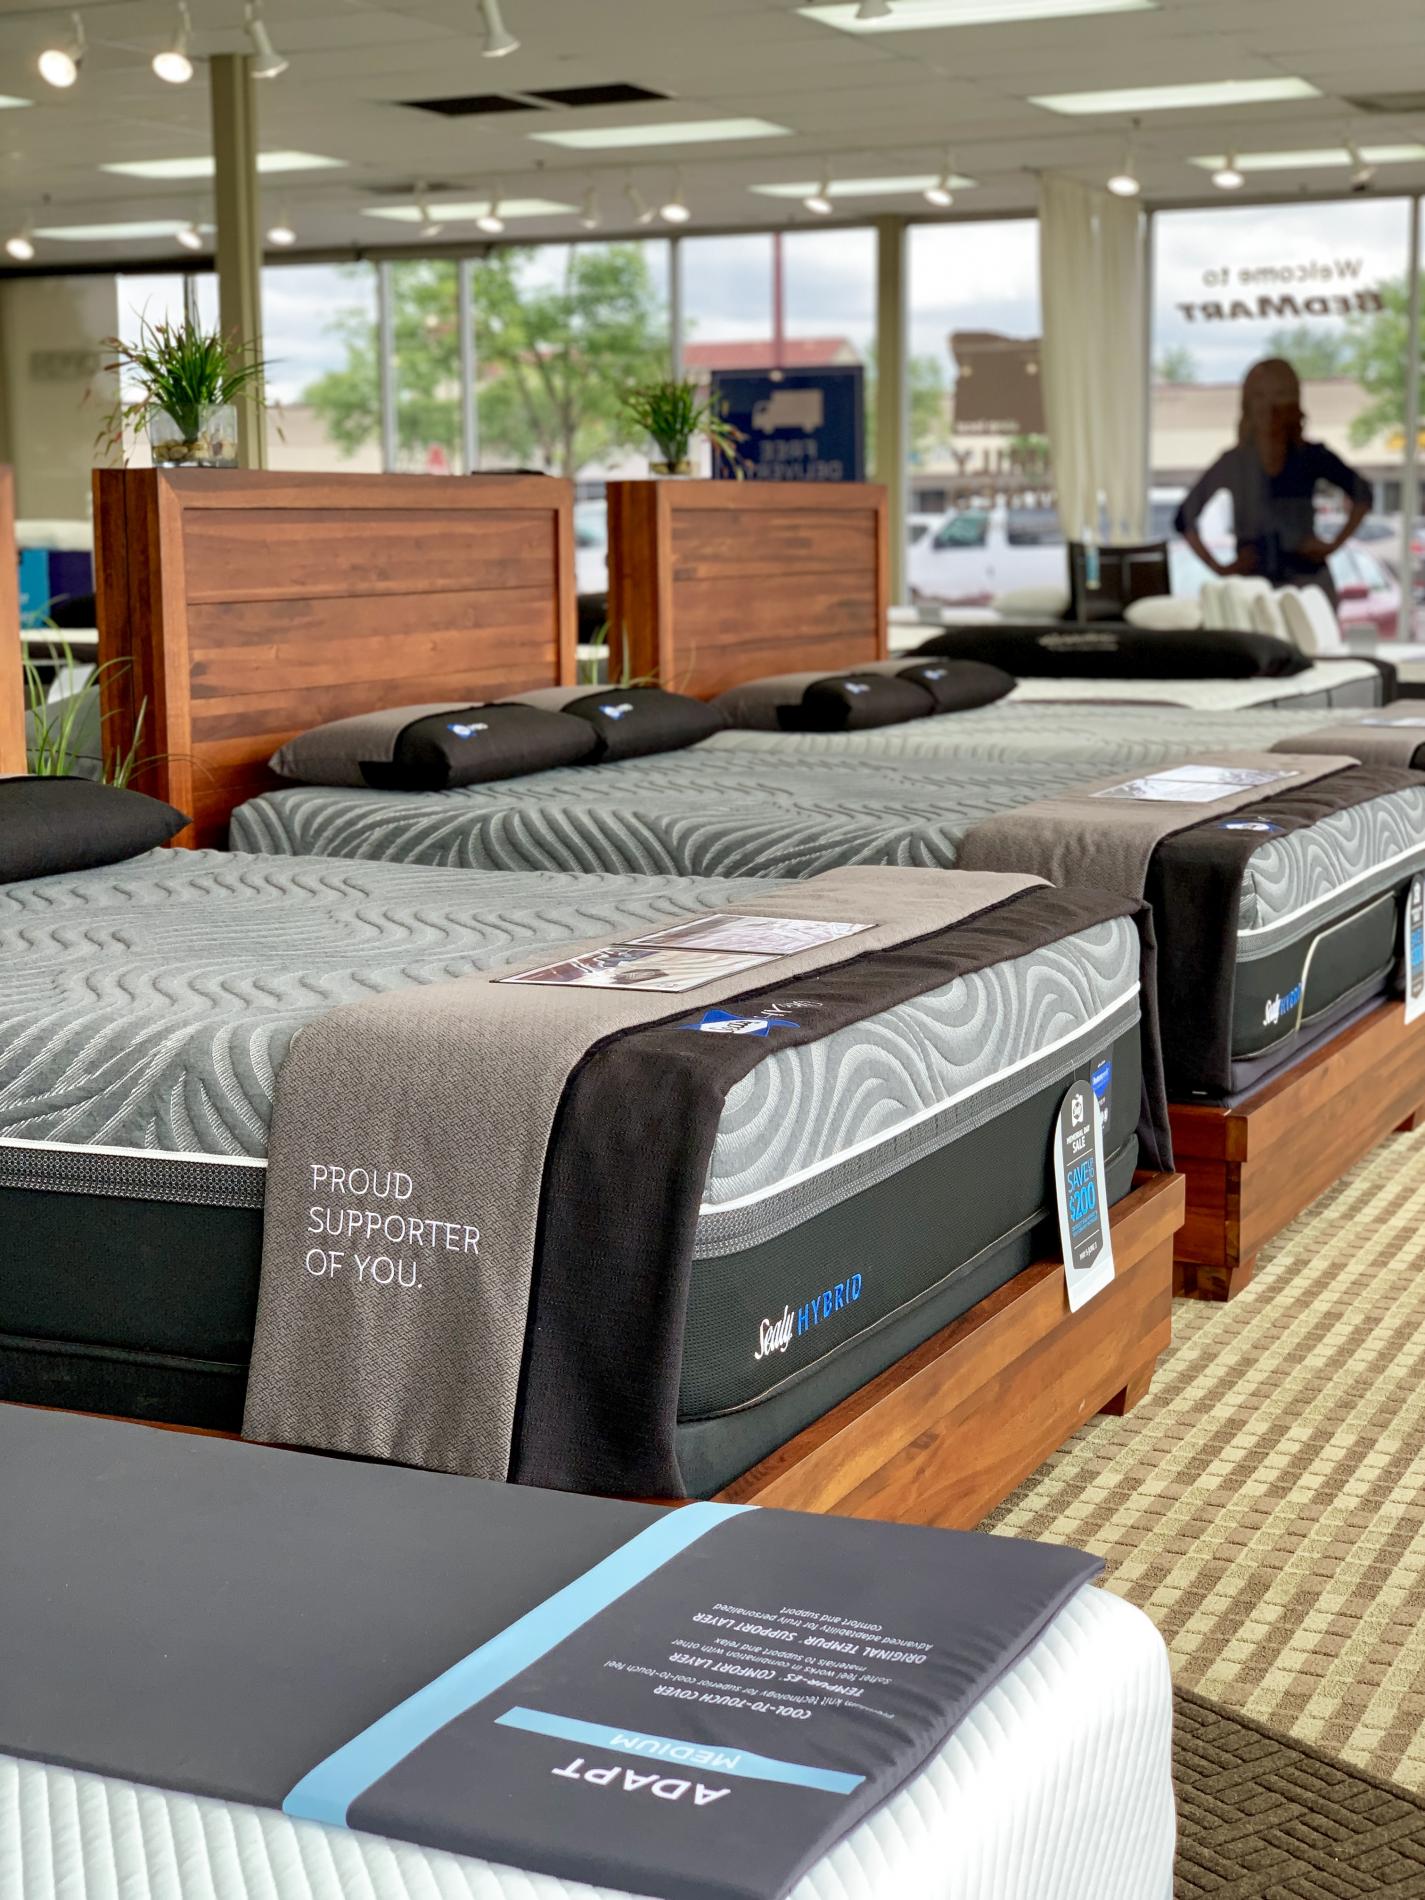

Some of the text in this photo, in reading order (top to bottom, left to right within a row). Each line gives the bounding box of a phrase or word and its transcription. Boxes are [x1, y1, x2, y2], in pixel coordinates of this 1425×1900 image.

[1072, 1135, 1086, 1154] SALE
[310, 1164, 413, 1200] PROUD
[1067, 1161, 1089, 1193] SAVE
[1069, 1181, 1096, 1221] $200
[307, 1206, 481, 1255] SUPPORTER
[305, 1249, 423, 1289] OF YOU.
[754, 1273, 862, 1360] Sealy HYBRID
[692, 1611, 736, 1629] LAYER
[712, 1603, 934, 1652] Advanced adaptability for truly personalized
[779, 1606, 882, 1632] comfort and support
[733, 1621, 798, 1642] SUPPORT
[671, 1639, 700, 1651] other
[700, 1645, 725, 1656] with
[713, 1637, 740, 1649] relax
[740, 1643, 761, 1653] and
[669, 1652, 713, 1669] LAYER
[726, 1650, 791, 1669] combination
[761, 1648, 804, 1664] support
[862, 1646, 928, 1664] ORIGINAL
[603, 1659, 627, 1672] feel
[627, 1664, 697, 1685] cool-to-touch
[711, 1662, 776, 1680] COMFORT
[803, 1666, 836, 1678] works
[818, 1659, 868, 1672] materials
[836, 1671, 858, 1682] feel
[858, 1674, 892, 1686] Softer
[697, 1679, 742, 1693] superior
[741, 1687, 759, 1697] for
[653, 1685, 812, 1720] COOL-TO-TOUCH COVER
[759, 1690, 820, 1706] technology
[821, 1696, 843, 1707] knit
[609, 1733, 741, 1769] MEDIUM
[551, 1757, 731, 1806] ADAPT
